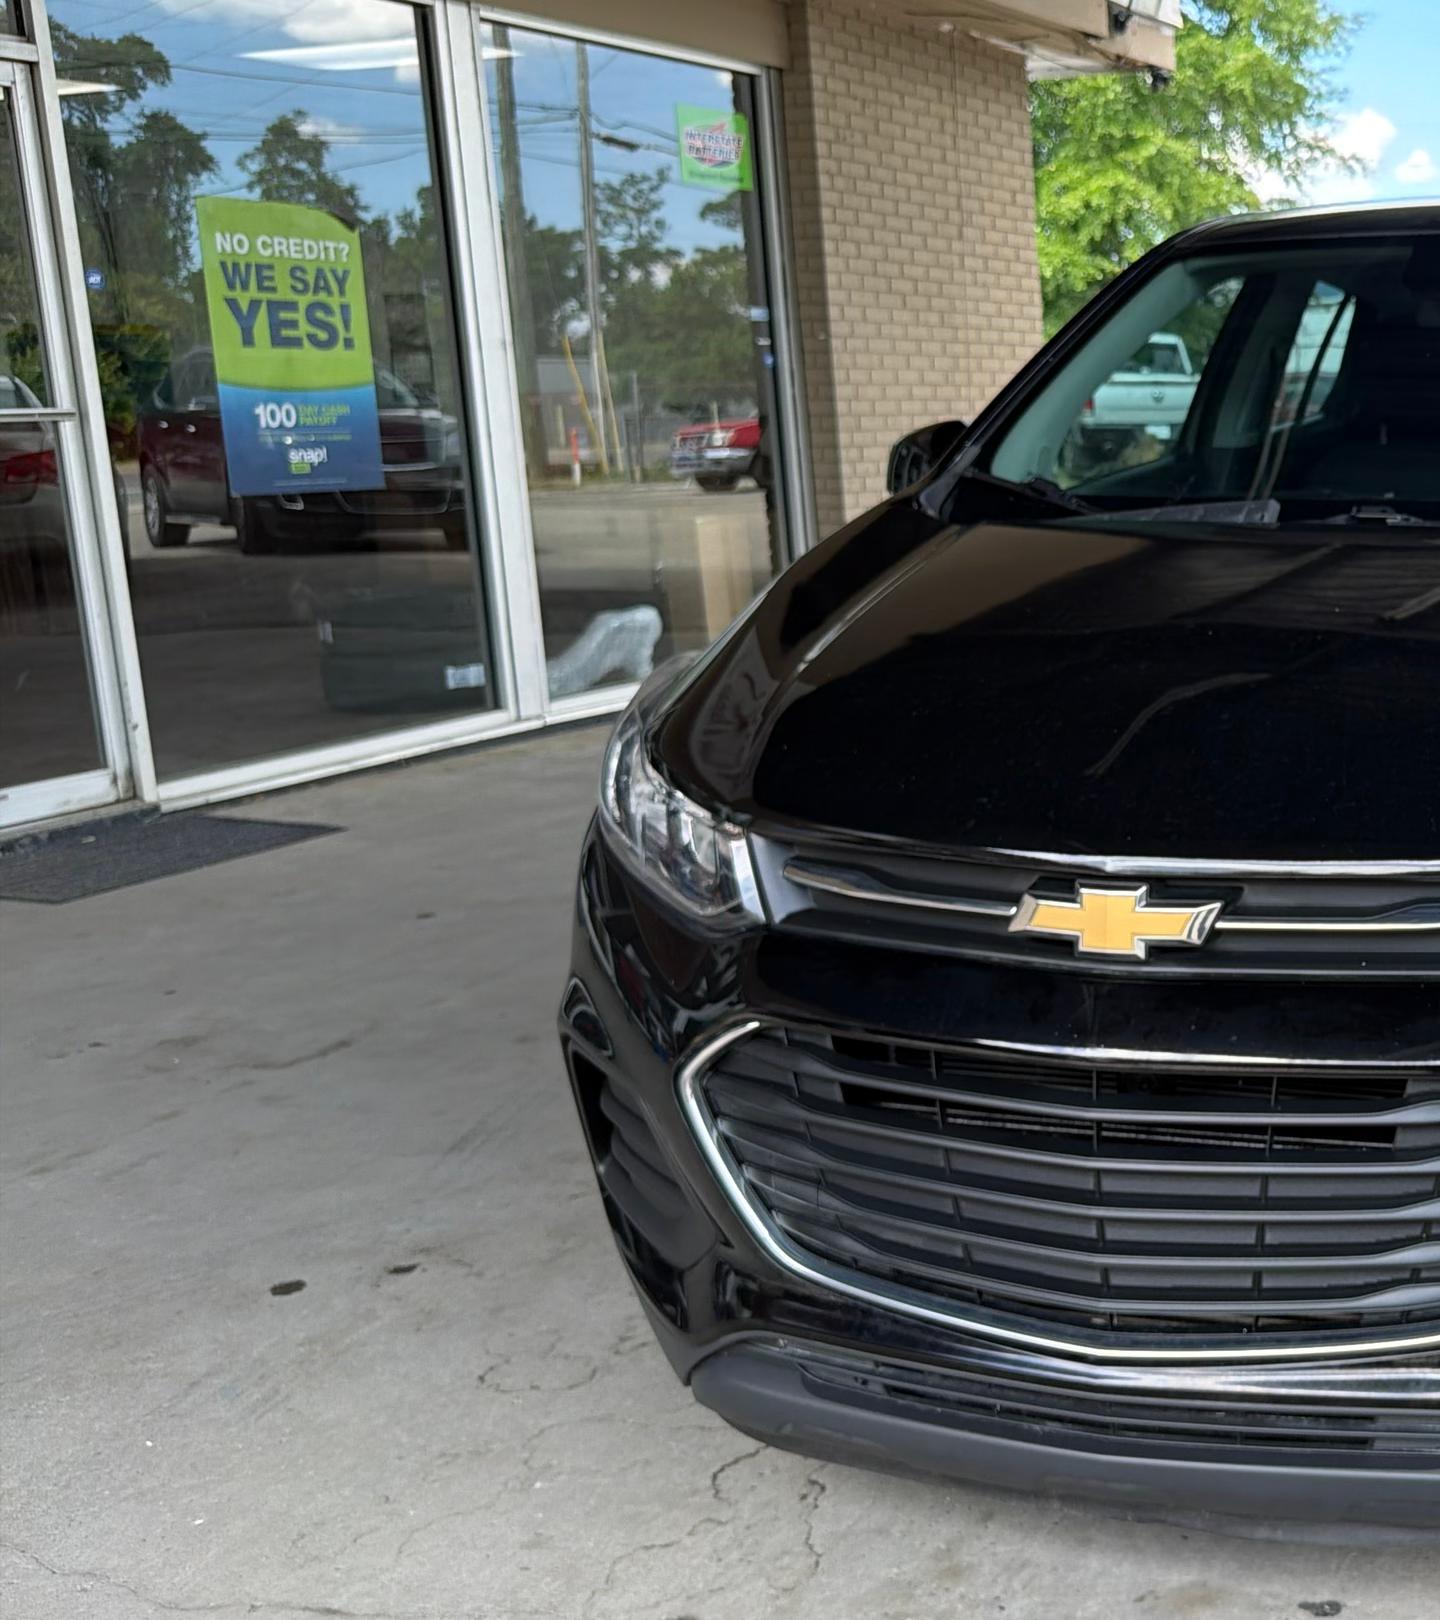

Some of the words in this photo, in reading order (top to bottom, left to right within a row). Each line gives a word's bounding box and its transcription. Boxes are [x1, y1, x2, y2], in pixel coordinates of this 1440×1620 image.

[214, 231, 250, 255] NO
[256, 234, 350, 262] CREDIT?
[219, 260, 278, 294] WE
[289, 265, 351, 298] SAY
[224, 297, 355, 351] YES!
[255, 402, 297, 429] 100
[288, 447, 328, 467] snap!
